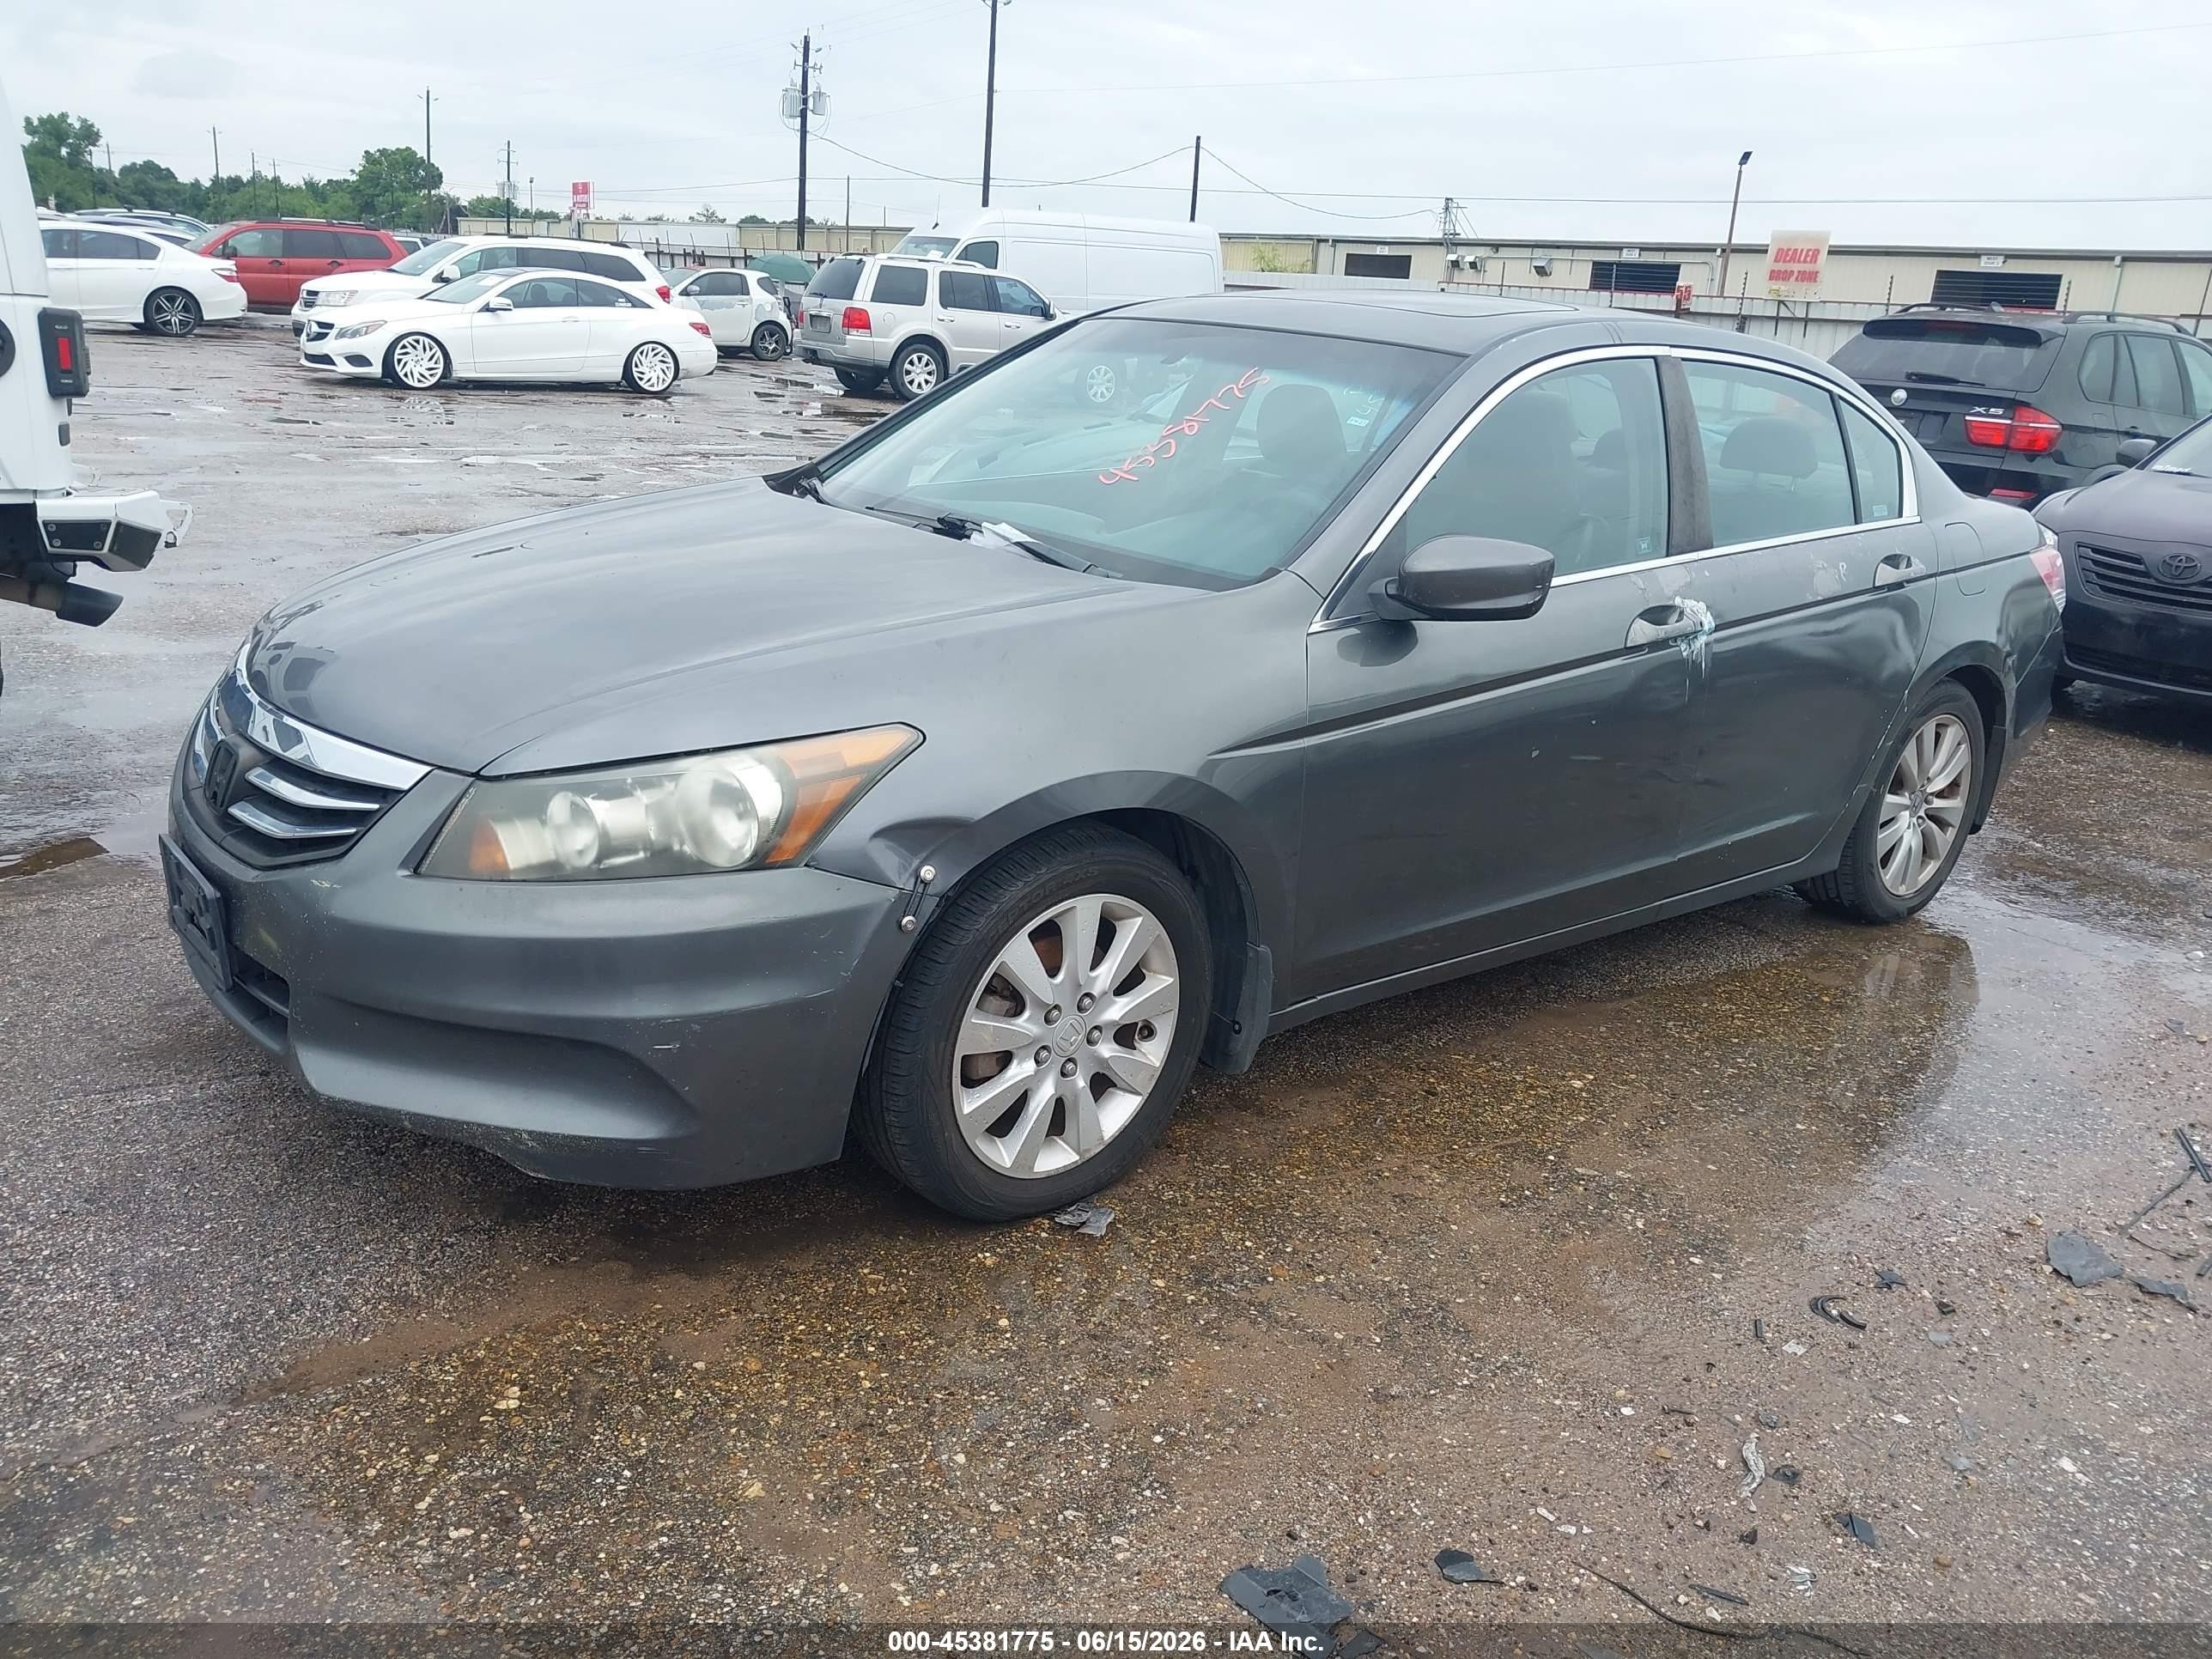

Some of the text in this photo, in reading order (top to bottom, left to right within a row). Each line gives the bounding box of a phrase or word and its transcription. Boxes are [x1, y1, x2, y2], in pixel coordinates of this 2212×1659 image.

[1773, 247, 1820, 264] DEALER
[1768, 269, 1820, 283] DROP ZONE
[1970, 406, 2006, 415] X5
